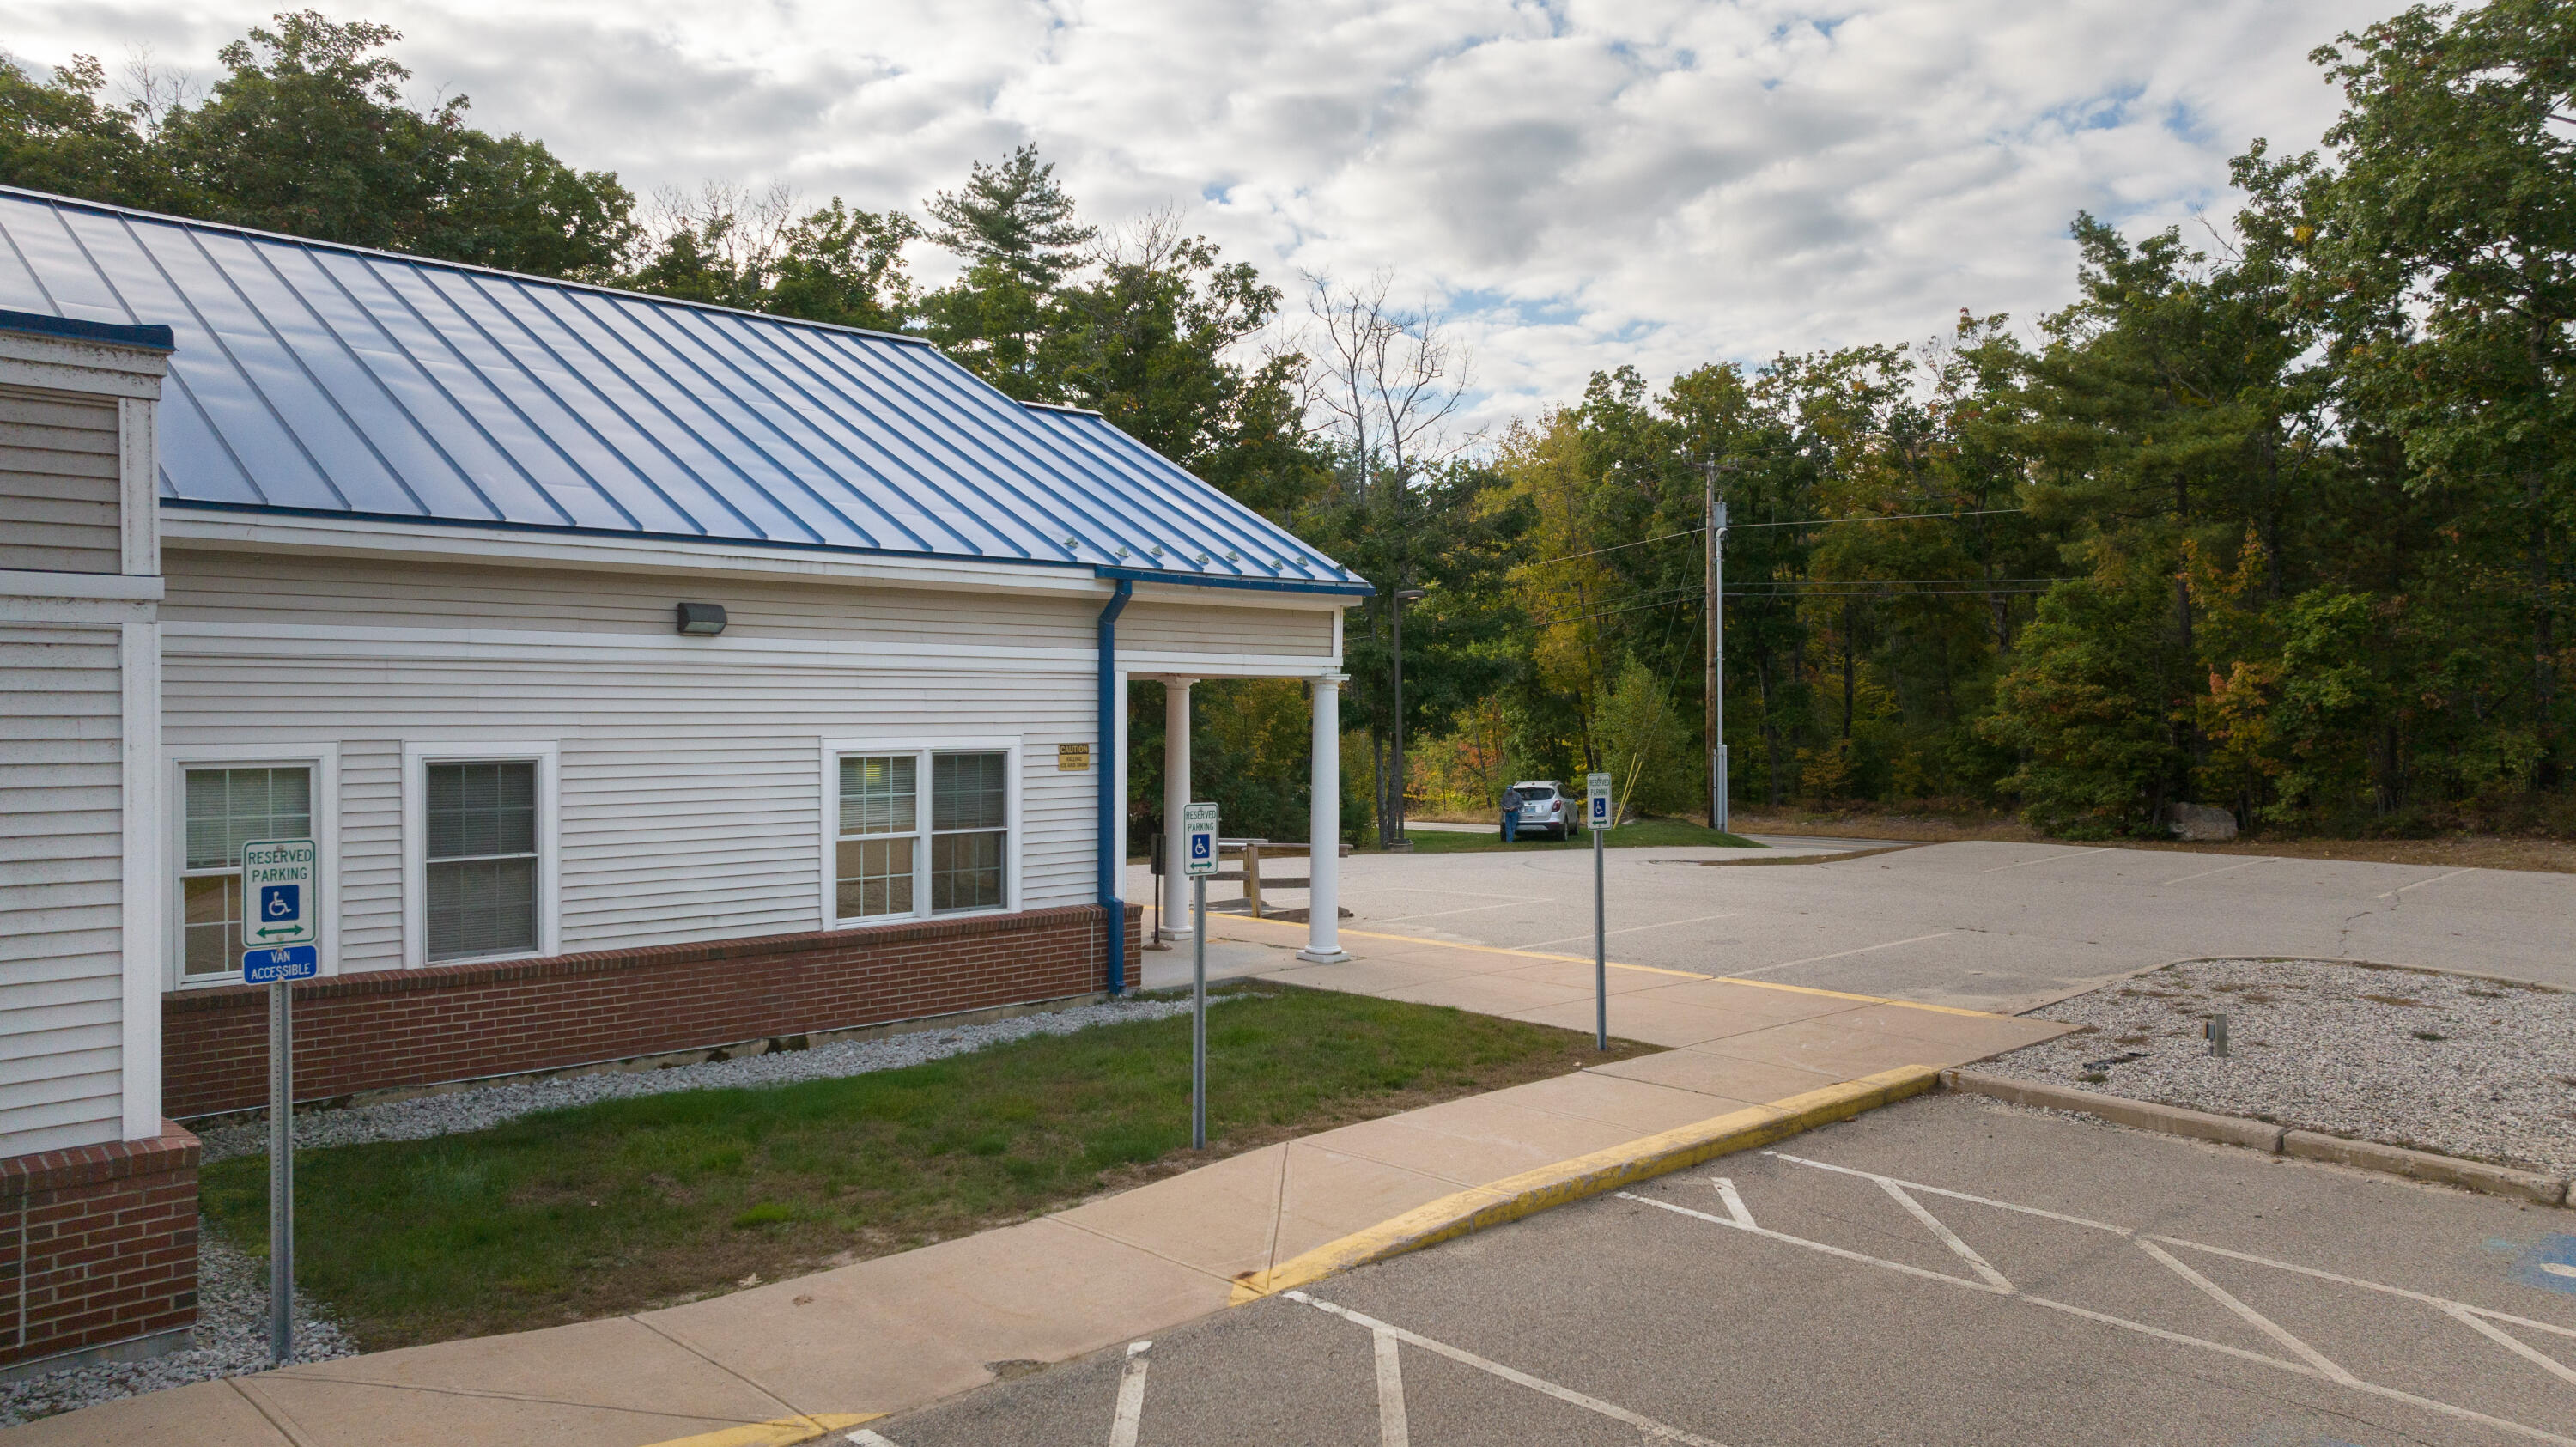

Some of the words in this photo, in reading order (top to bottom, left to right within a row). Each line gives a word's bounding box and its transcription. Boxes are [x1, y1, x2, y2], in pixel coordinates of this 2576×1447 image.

[1060, 745, 1088, 754] CAUTION
[1186, 810, 1216, 820] RESERVED
[1188, 823, 1214, 832] PARKING
[248, 848, 313, 865] RESERVED
[252, 867, 308, 882] PARKING
[270, 951, 291, 963] VAN
[251, 963, 311, 980] ACCESSIBLE
